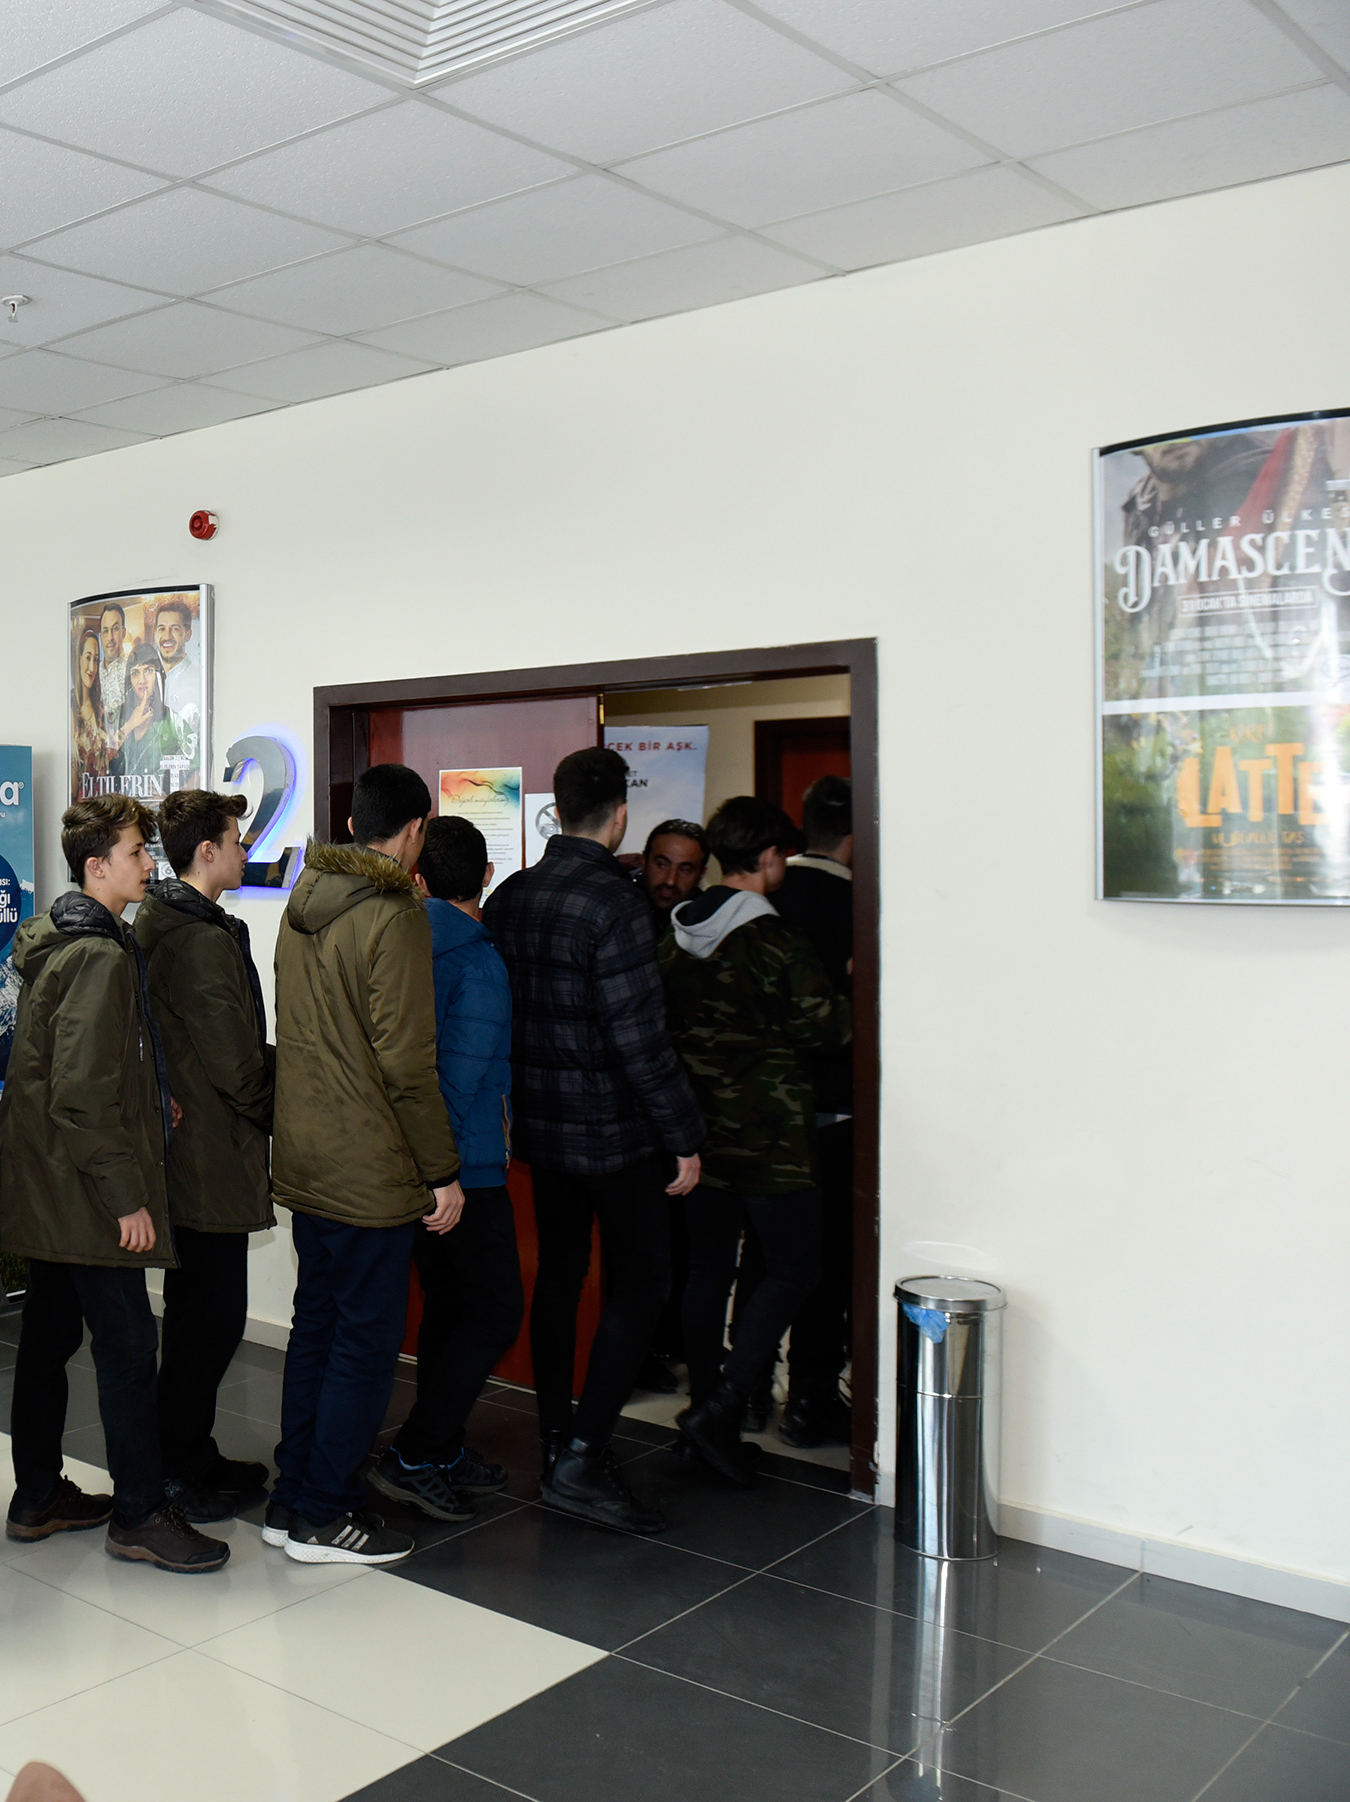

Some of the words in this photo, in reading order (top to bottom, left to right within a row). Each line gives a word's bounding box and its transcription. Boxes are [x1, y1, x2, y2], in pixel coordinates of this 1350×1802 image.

[1148, 515, 1241, 538] GÜLLER
[223, 735, 303, 888] 2
[1176, 742, 1333, 828] LATTE
